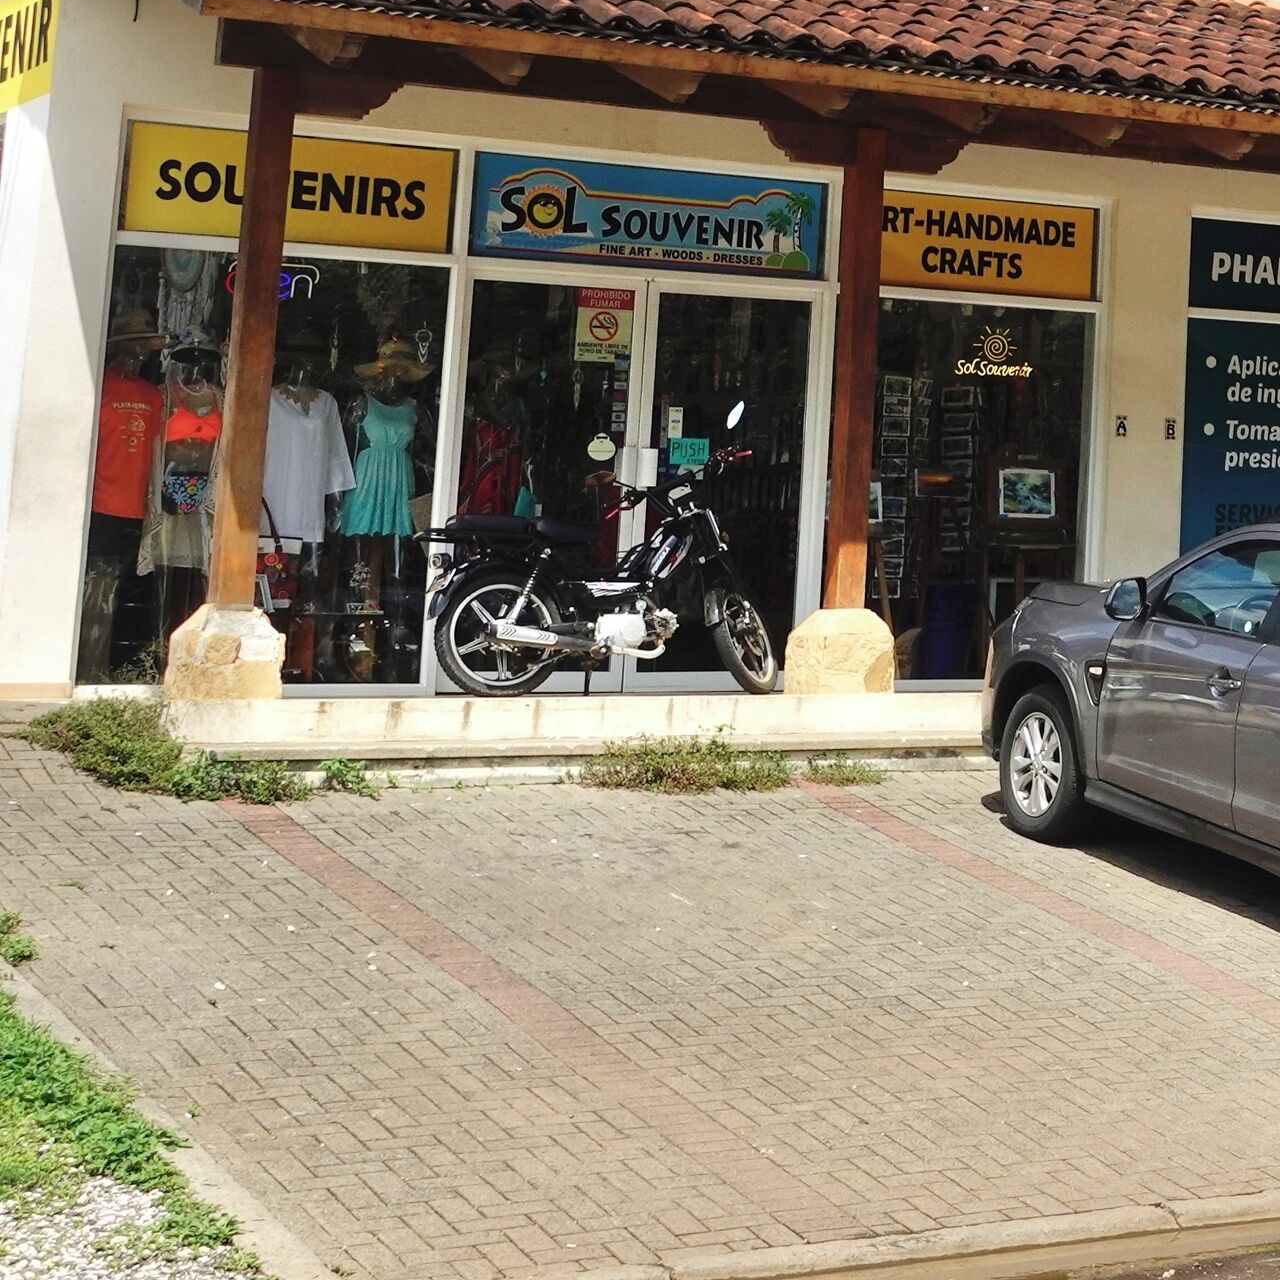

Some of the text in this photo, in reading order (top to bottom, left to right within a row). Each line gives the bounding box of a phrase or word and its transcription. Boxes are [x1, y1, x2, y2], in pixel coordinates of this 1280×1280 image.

[155, 159, 426, 220] SOUENIRS
[500, 184, 588, 234] SOL
[601, 206, 765, 250] SOUVENIR
[882, 205, 1076, 248] RT-HANDMADE
[599, 244, 626, 255] FINE
[629, 247, 652, 257] ART
[662, 249, 704, 261] WOODS
[713, 253, 763, 266] DRESSES
[921, 246, 1023, 279] CRAFTS
[582, 289, 631, 300] PROHIBIDO
[590, 299, 620, 308] FUMAR
[954, 358, 980, 375] Sol
[1226, 382, 1252, 402] de
[1226, 419, 1280, 441] Toma
[671, 441, 705, 458] PUSH
